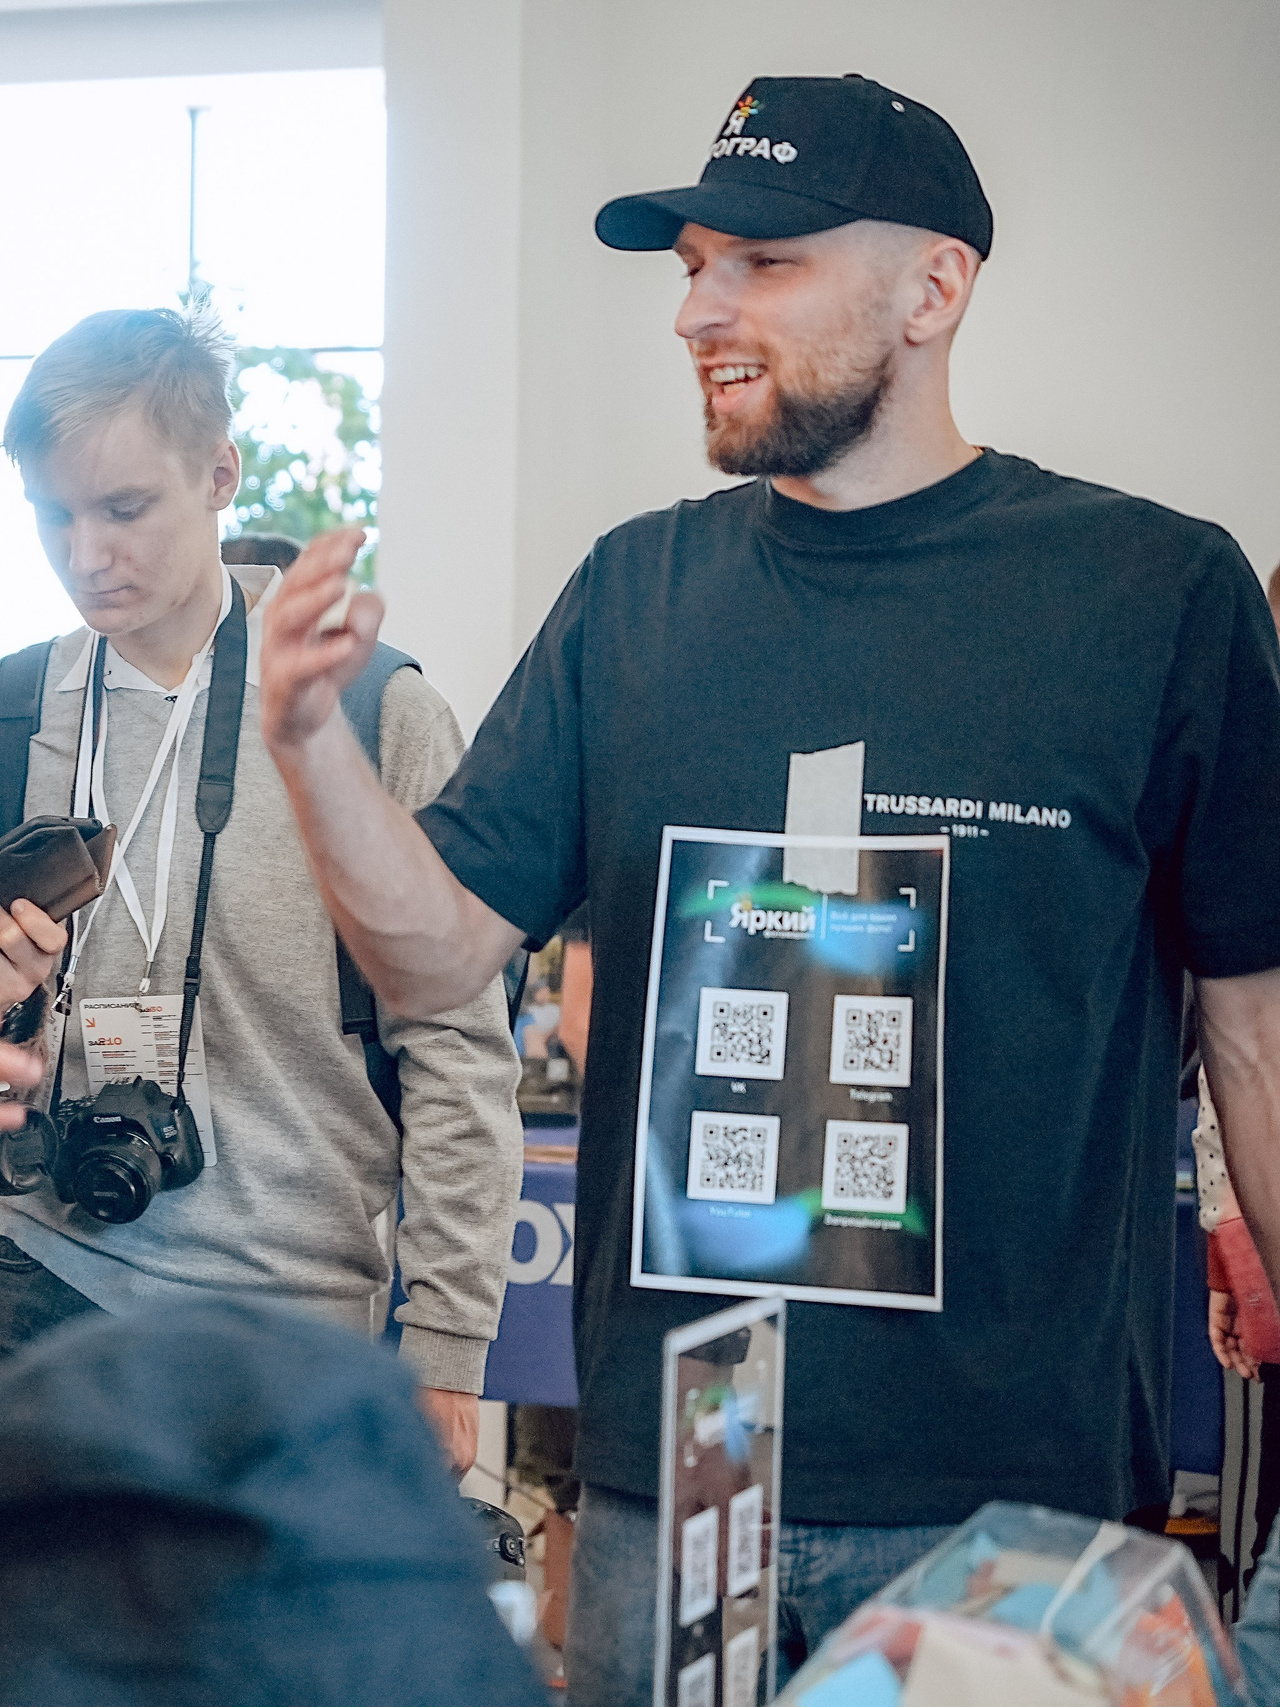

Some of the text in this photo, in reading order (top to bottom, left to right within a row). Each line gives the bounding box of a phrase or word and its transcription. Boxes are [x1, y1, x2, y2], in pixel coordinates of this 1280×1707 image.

[863, 793, 1073, 829] TRUSSARDI MILANO
[728, 901, 817, 936] Яркий
